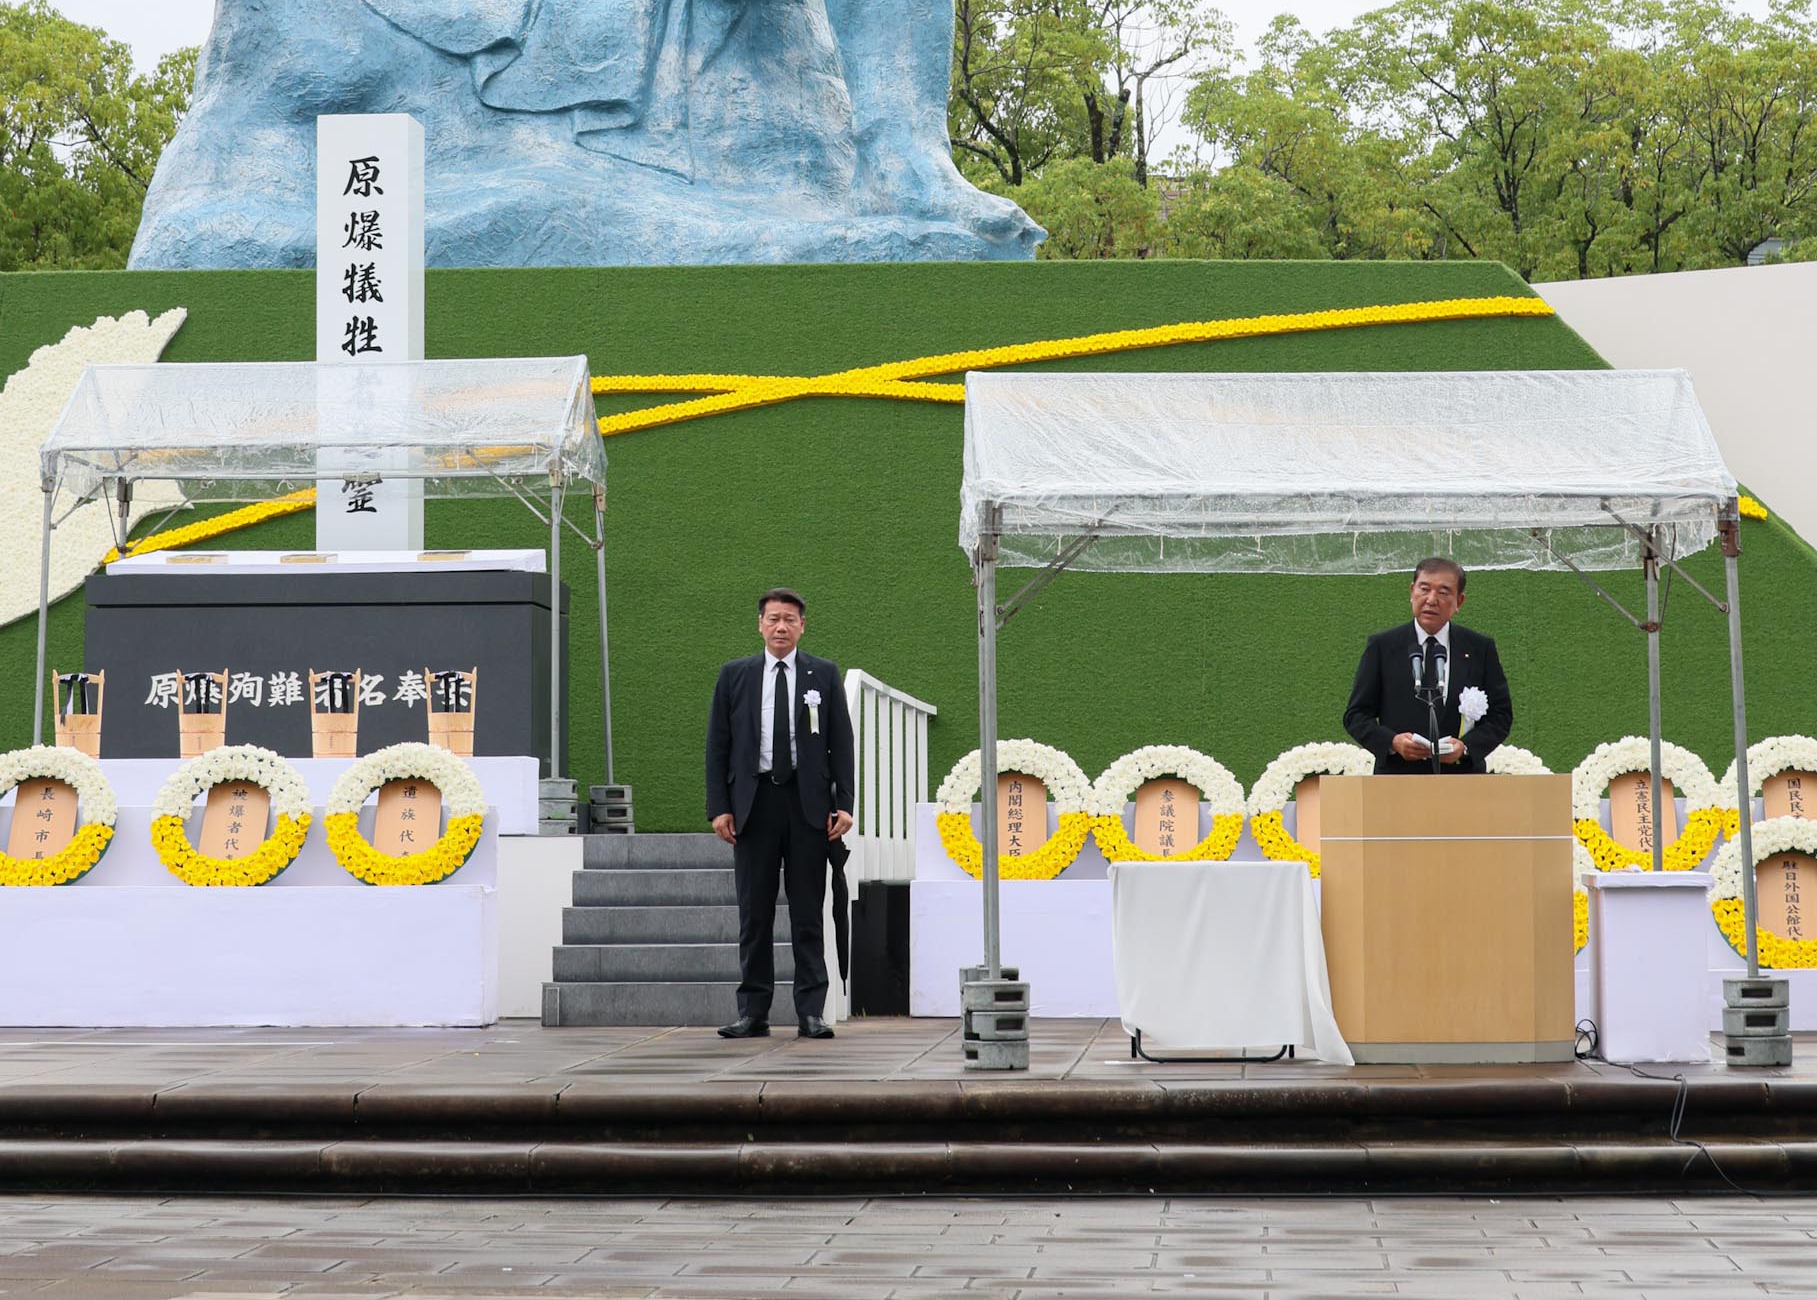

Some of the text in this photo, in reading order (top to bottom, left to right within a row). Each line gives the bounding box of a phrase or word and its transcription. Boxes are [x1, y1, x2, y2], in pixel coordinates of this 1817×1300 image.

[342, 155, 384, 513] 原爆犠牲霊
[1007, 780, 1024, 857] 内閣総理大臣
